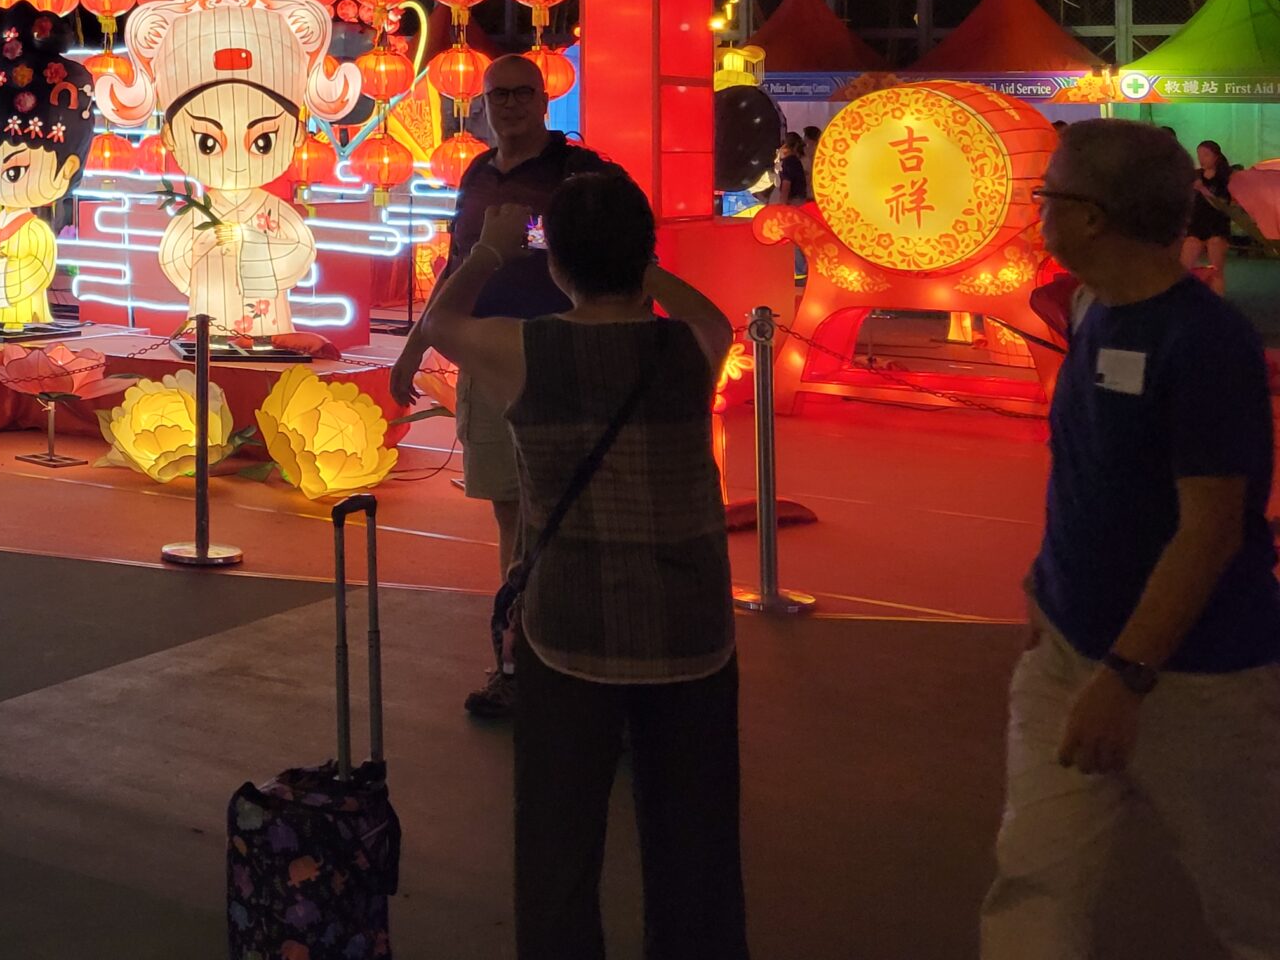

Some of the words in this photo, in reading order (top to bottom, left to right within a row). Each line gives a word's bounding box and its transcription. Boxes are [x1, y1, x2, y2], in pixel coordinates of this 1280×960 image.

[770, 83, 786, 93] Police
[786, 83, 812, 96] Reporting
[1000, 82, 1015, 94] Aid
[1016, 83, 1052, 94] Service
[1164, 80, 1218, 94] 救護站
[1225, 83, 1251, 94] First
[1254, 82, 1274, 94] Aid
[884, 125, 936, 230] 吉祥
